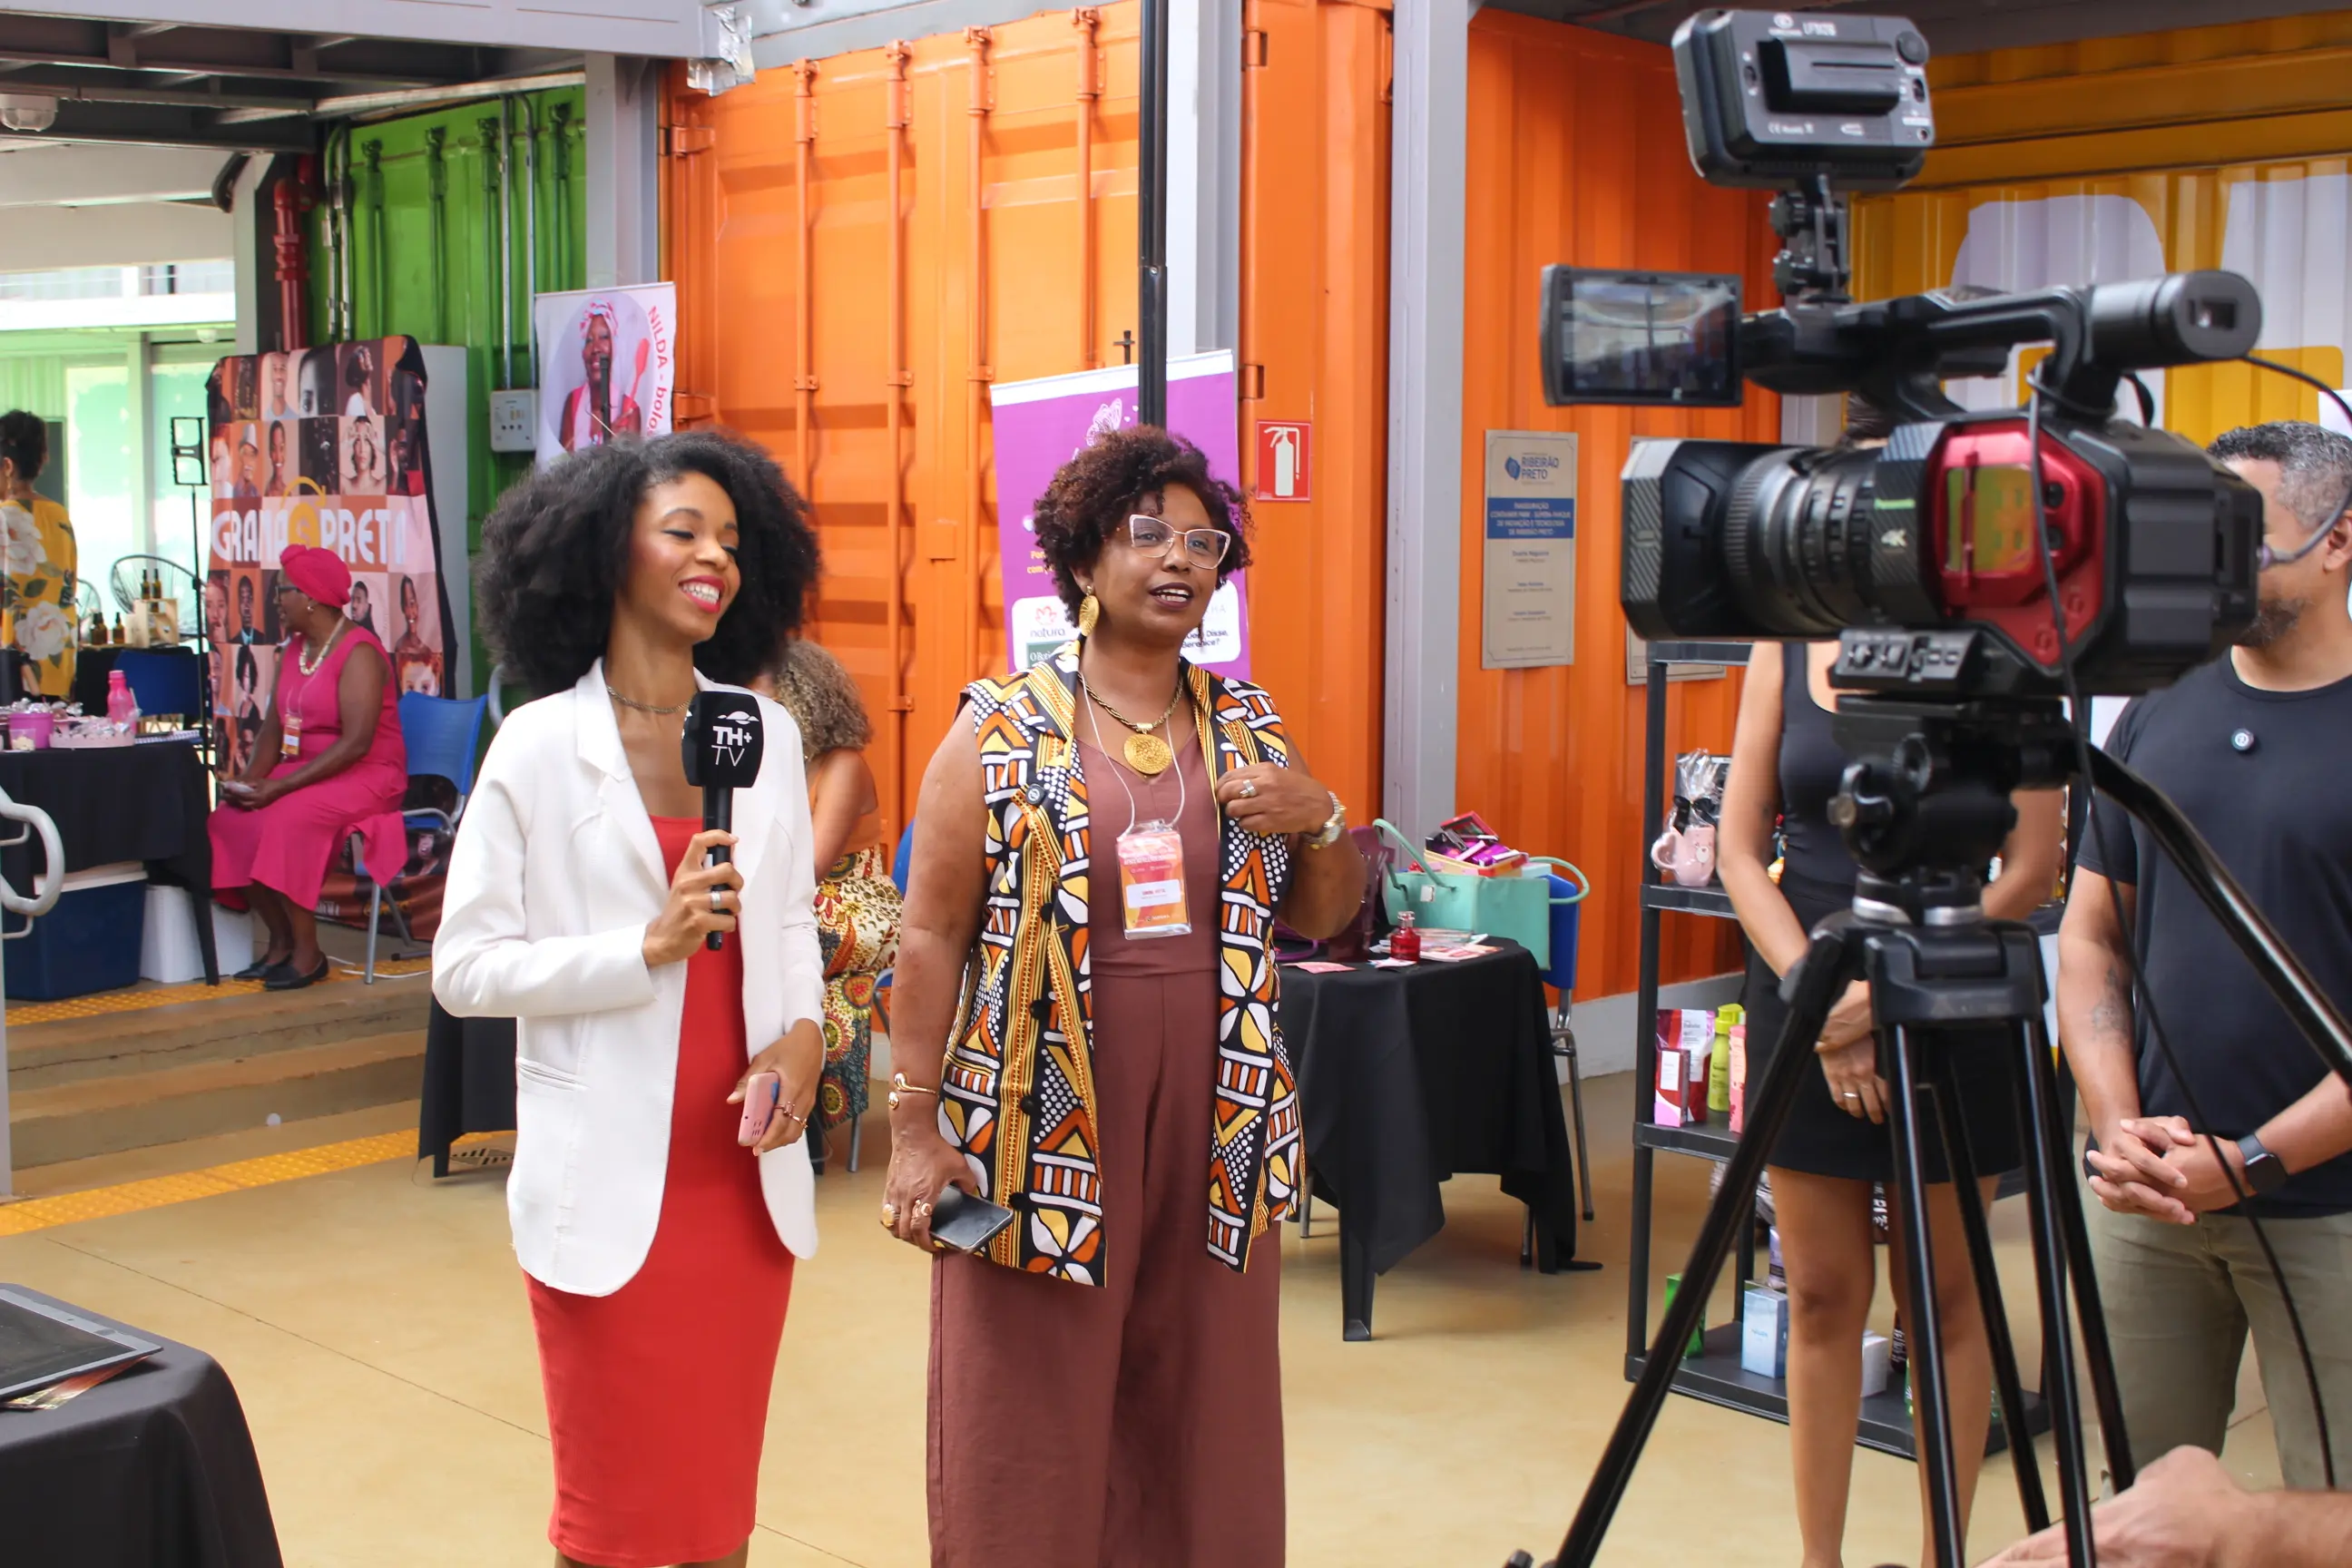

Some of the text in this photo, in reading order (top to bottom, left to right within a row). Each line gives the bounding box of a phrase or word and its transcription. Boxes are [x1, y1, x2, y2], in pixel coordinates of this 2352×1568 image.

[648, 306, 668, 368] NILDA
[1522, 456, 1559, 468] RIBEIRÃO
[1522, 468, 1548, 480] PRETO
[211, 509, 289, 563] GRANA
[1030, 628, 1065, 639] natura
[712, 726, 752, 746] TH+
[711, 745, 745, 767] TV
